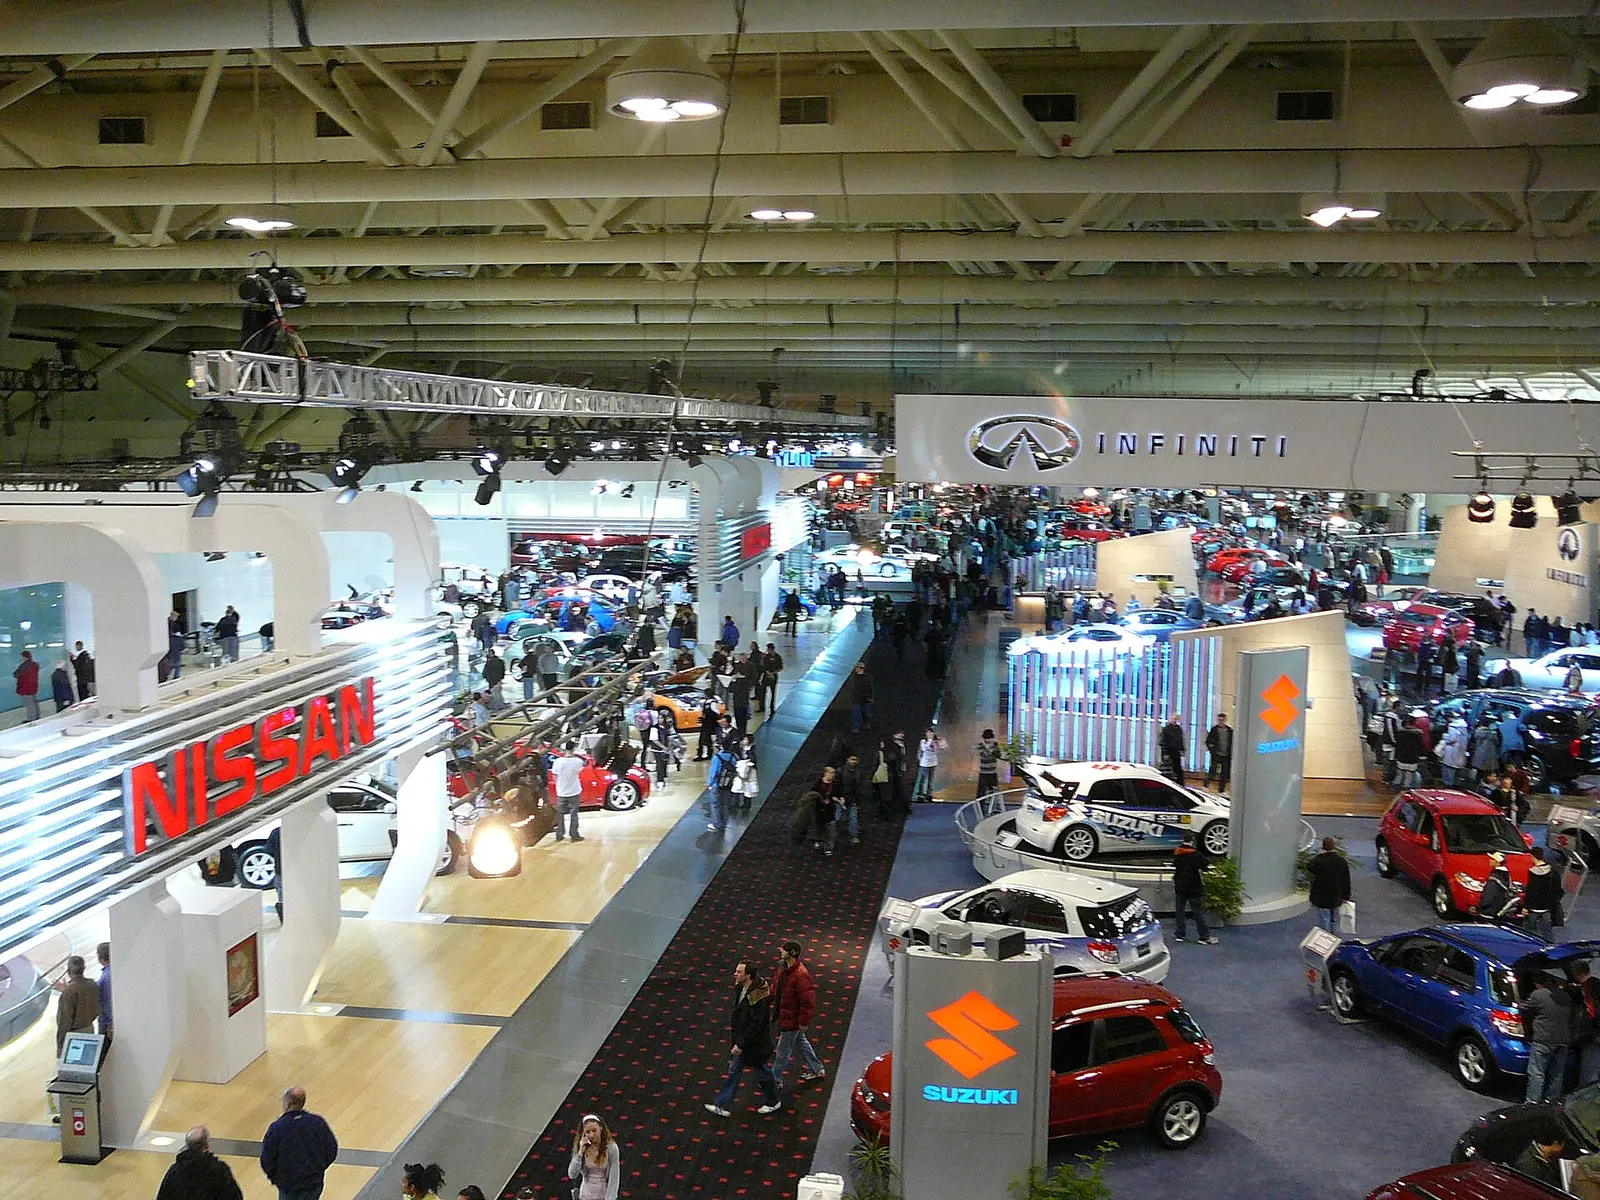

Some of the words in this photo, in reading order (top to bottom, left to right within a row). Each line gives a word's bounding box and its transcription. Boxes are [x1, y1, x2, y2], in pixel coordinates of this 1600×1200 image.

[1096, 433, 1288, 457] INFINITI
[1257, 738, 1298, 754] SUZUKI
[124, 676, 377, 856] NISSAN
[1091, 809, 1165, 837] SUZUKI
[923, 1084, 1018, 1105] SUZUKI
